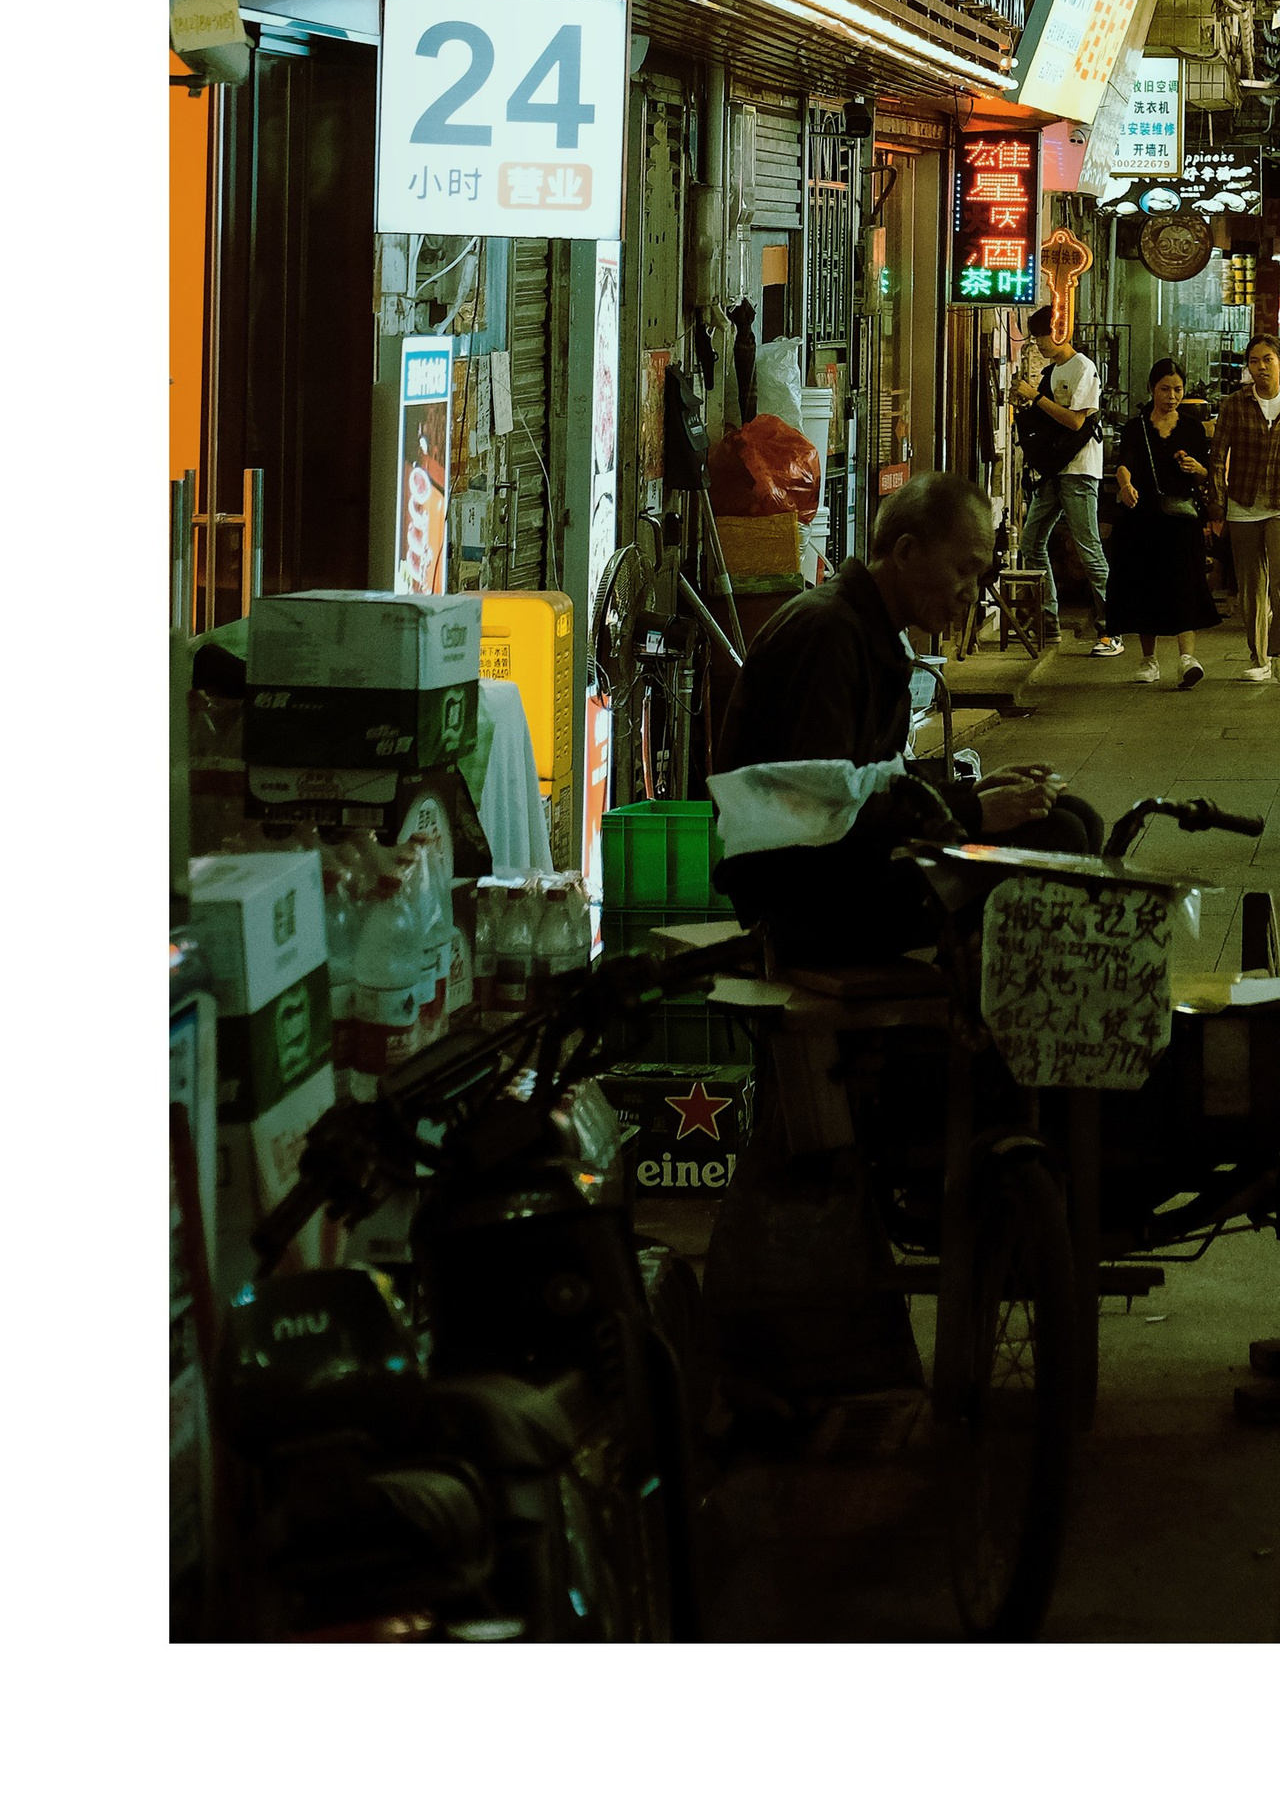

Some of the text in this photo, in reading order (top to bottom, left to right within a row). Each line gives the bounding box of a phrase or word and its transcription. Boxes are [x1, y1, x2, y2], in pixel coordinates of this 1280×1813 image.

[409, 20, 595, 149] 24
[1133, 101, 1170, 114] 洗衣机
[1133, 143, 1169, 157] 开墙孔
[408, 165, 583, 206] 小时 营业
[961, 267, 1033, 297] 茶叶
